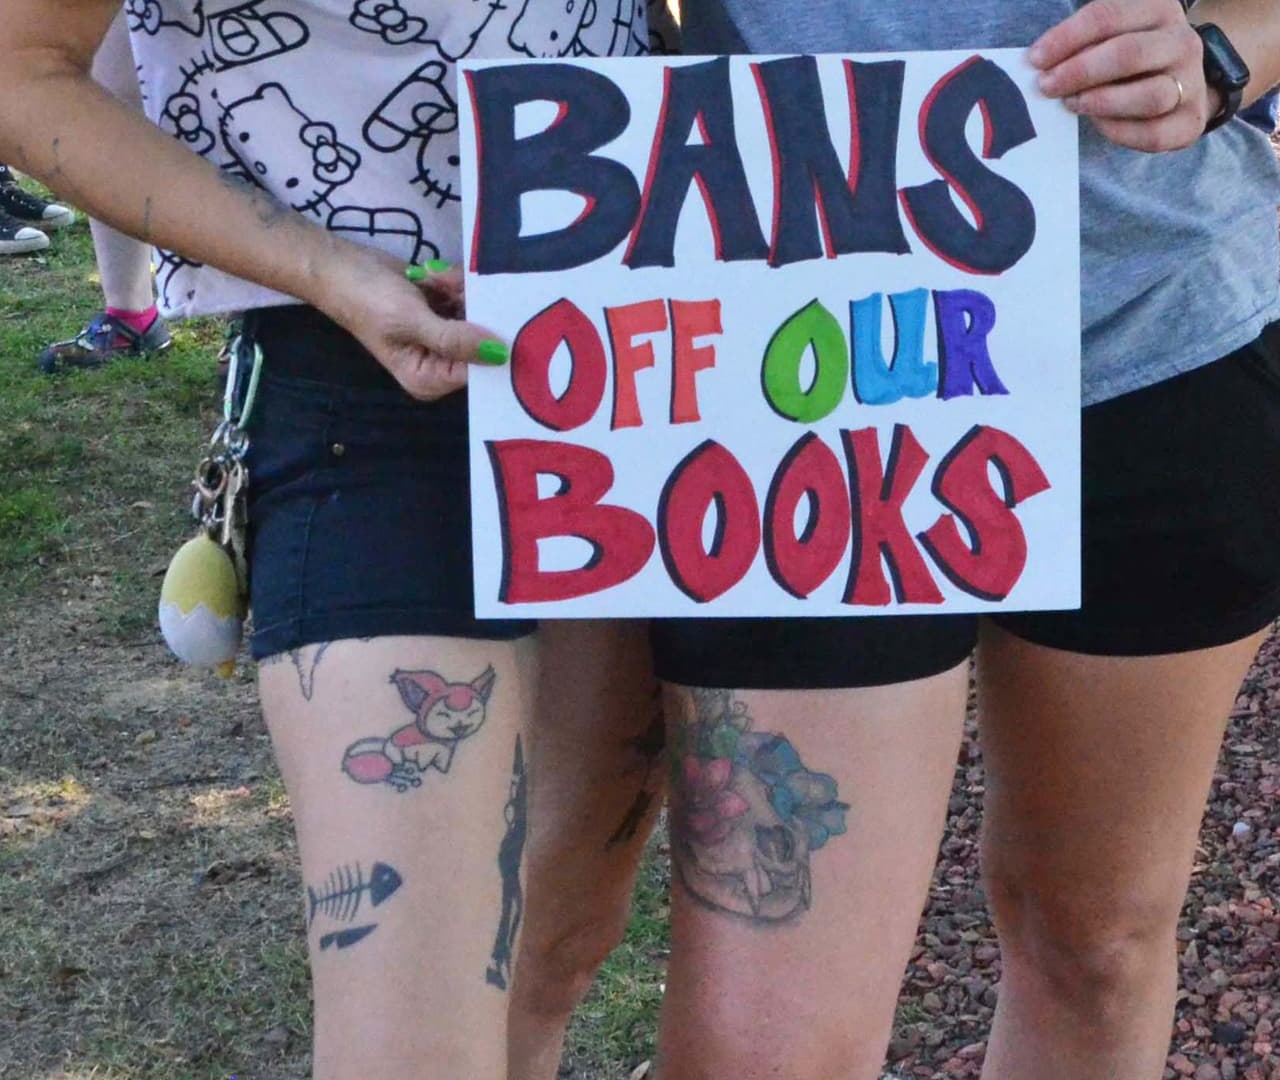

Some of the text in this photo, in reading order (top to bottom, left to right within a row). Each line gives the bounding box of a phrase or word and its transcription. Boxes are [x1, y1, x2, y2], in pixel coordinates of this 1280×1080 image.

[464, 55, 1038, 275] BANS
[510, 287, 1010, 432] OFF OUR
[484, 424, 1052, 605] BOOKS
